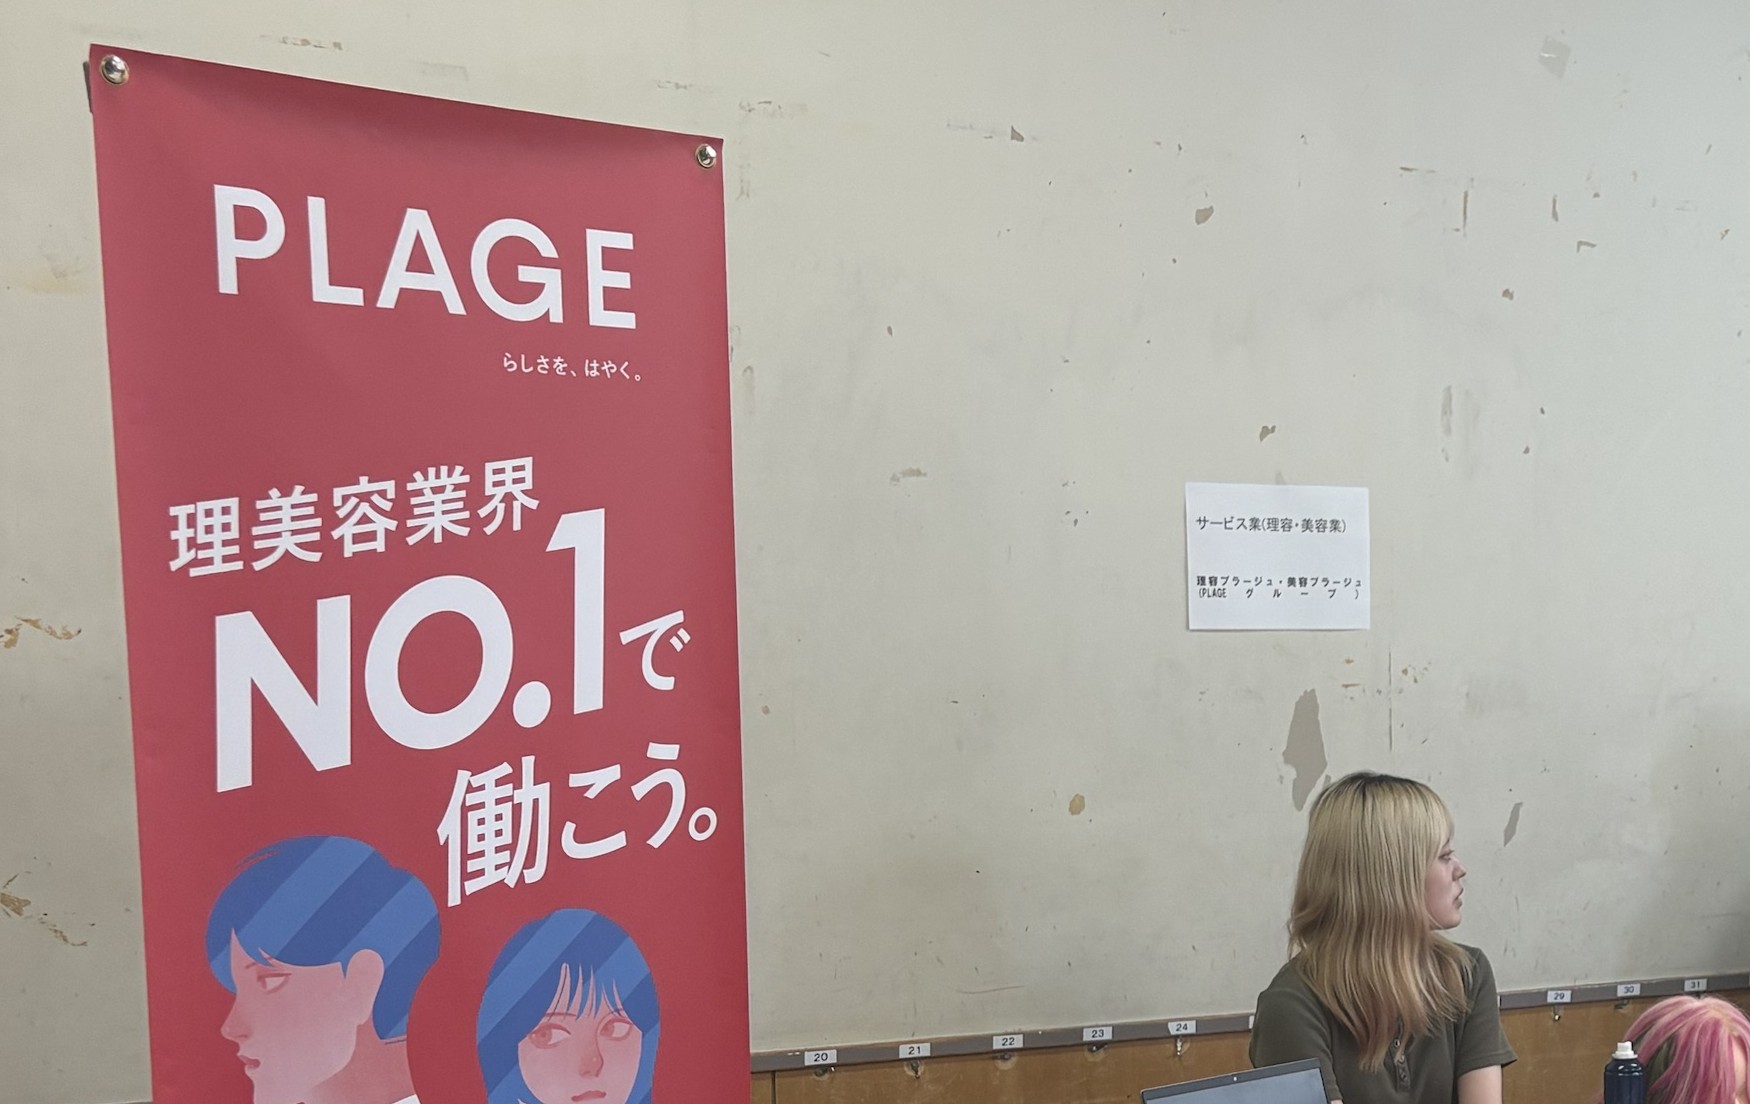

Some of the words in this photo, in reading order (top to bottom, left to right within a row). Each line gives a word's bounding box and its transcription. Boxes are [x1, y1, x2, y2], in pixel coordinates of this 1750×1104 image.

[213, 184, 637, 329] PLAGE
[503, 352, 641, 382] らしさを、はやく。
[168, 457, 540, 577] 理美容業界
[436, 742, 718, 907] 働こう。
[1624, 986, 1635, 995] 30
[1691, 981, 1701, 990] 31
[1554, 992, 1565, 1001] 29
[1176, 1022, 1189, 1033] 24
[1092, 1028, 1105, 1039] 23
[1002, 1036, 1015, 1048] 22
[909, 1045, 922, 1056] 21
[814, 1052, 828, 1063] 20
